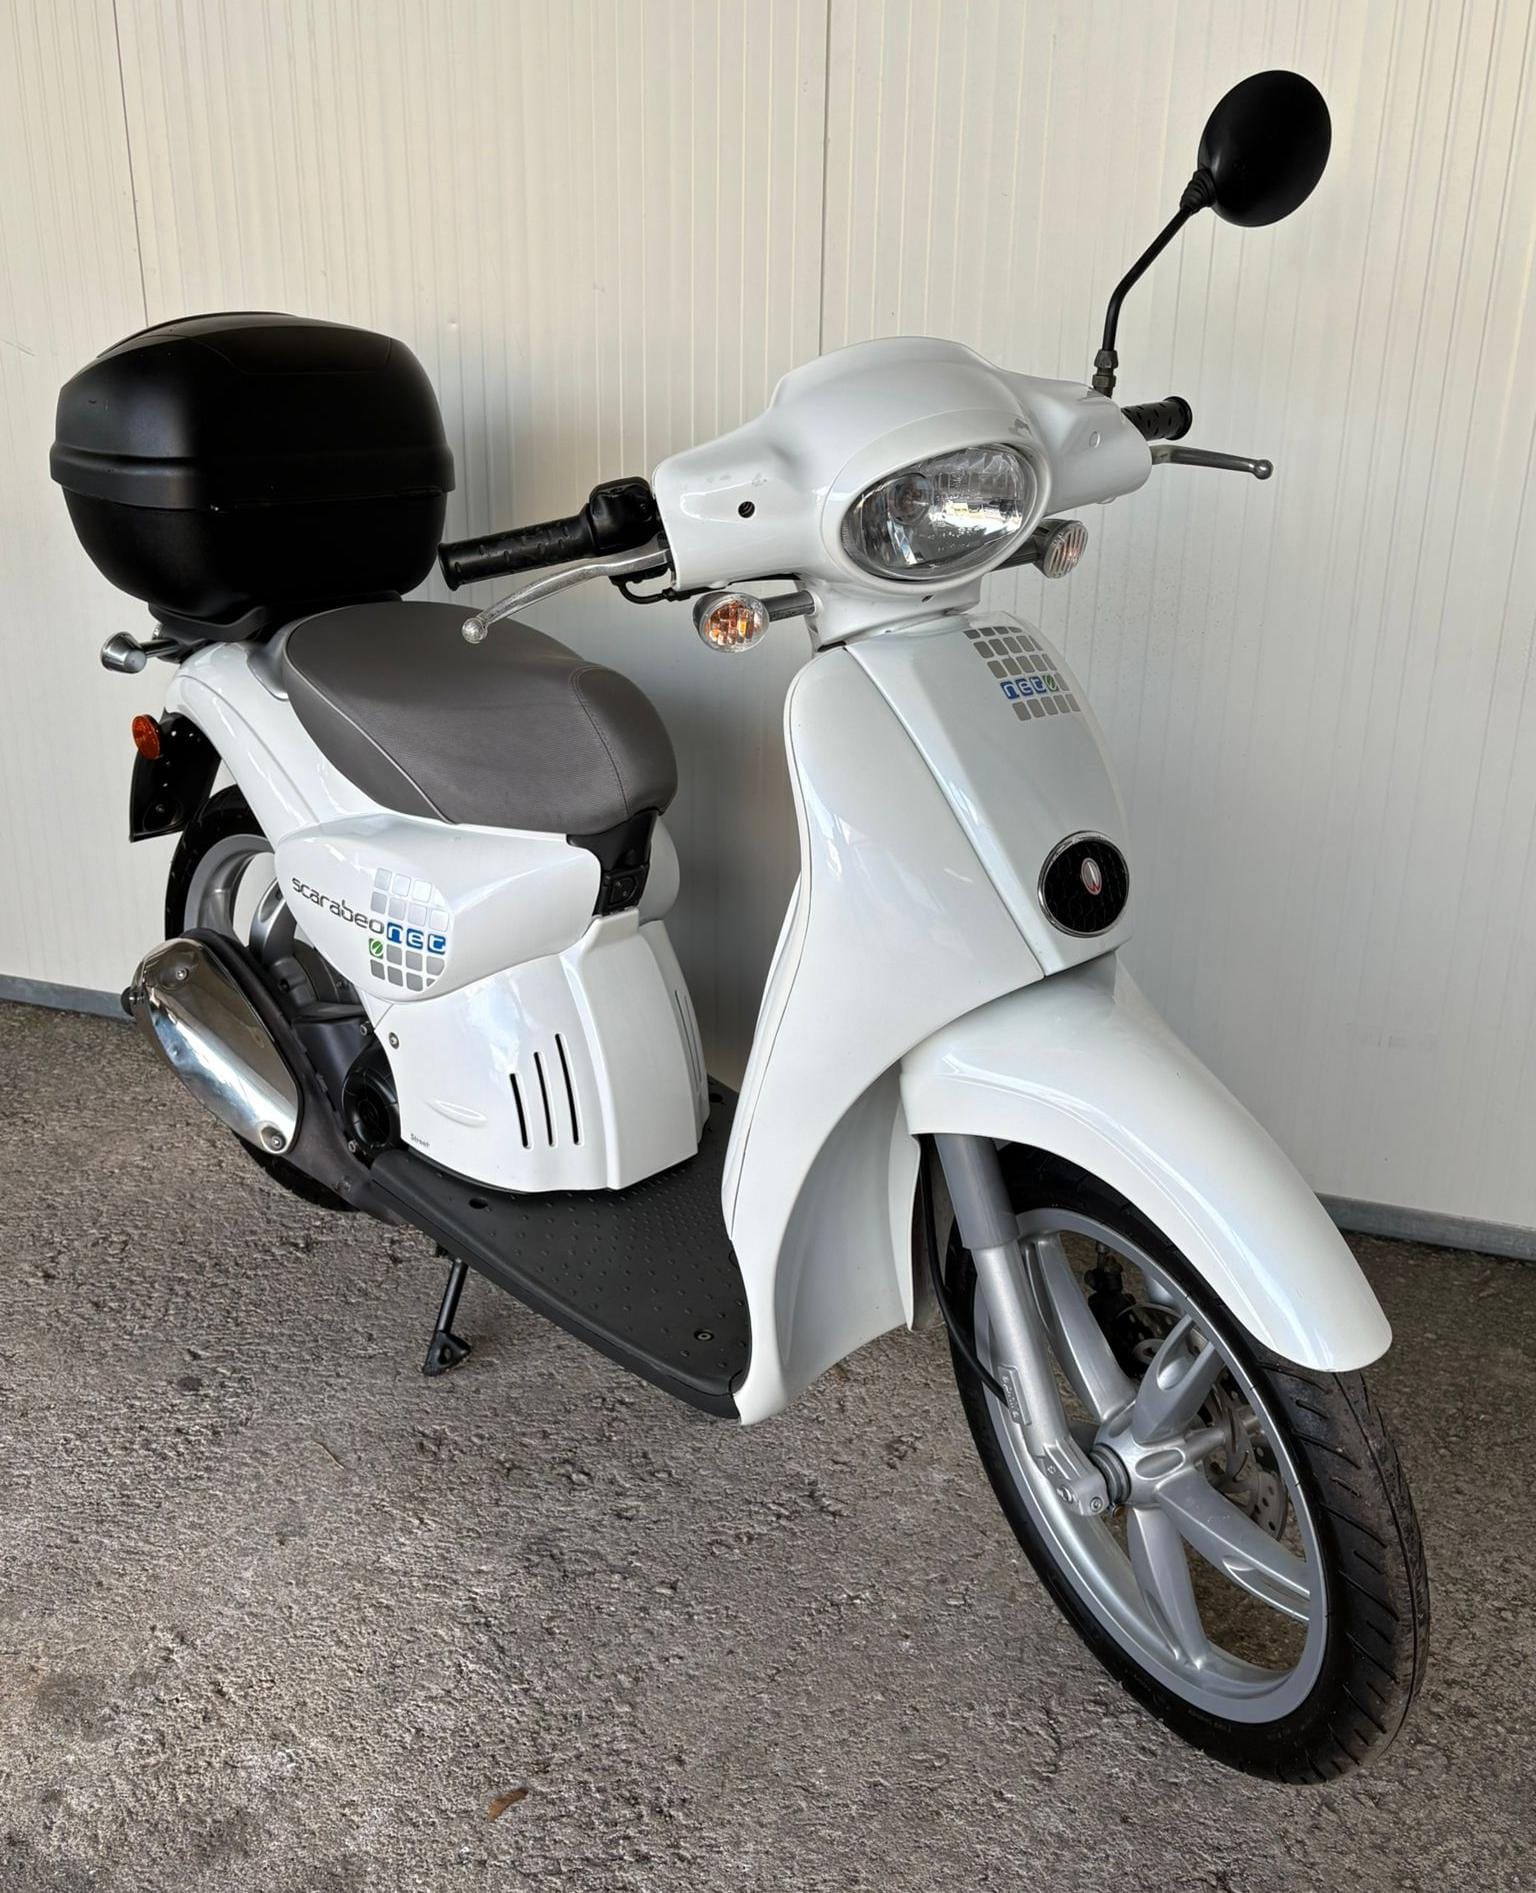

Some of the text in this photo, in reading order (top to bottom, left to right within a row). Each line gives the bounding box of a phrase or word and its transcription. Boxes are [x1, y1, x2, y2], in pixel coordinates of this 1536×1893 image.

[1001, 676, 1047, 699] net
[292, 877, 446, 955] scarabeo net
